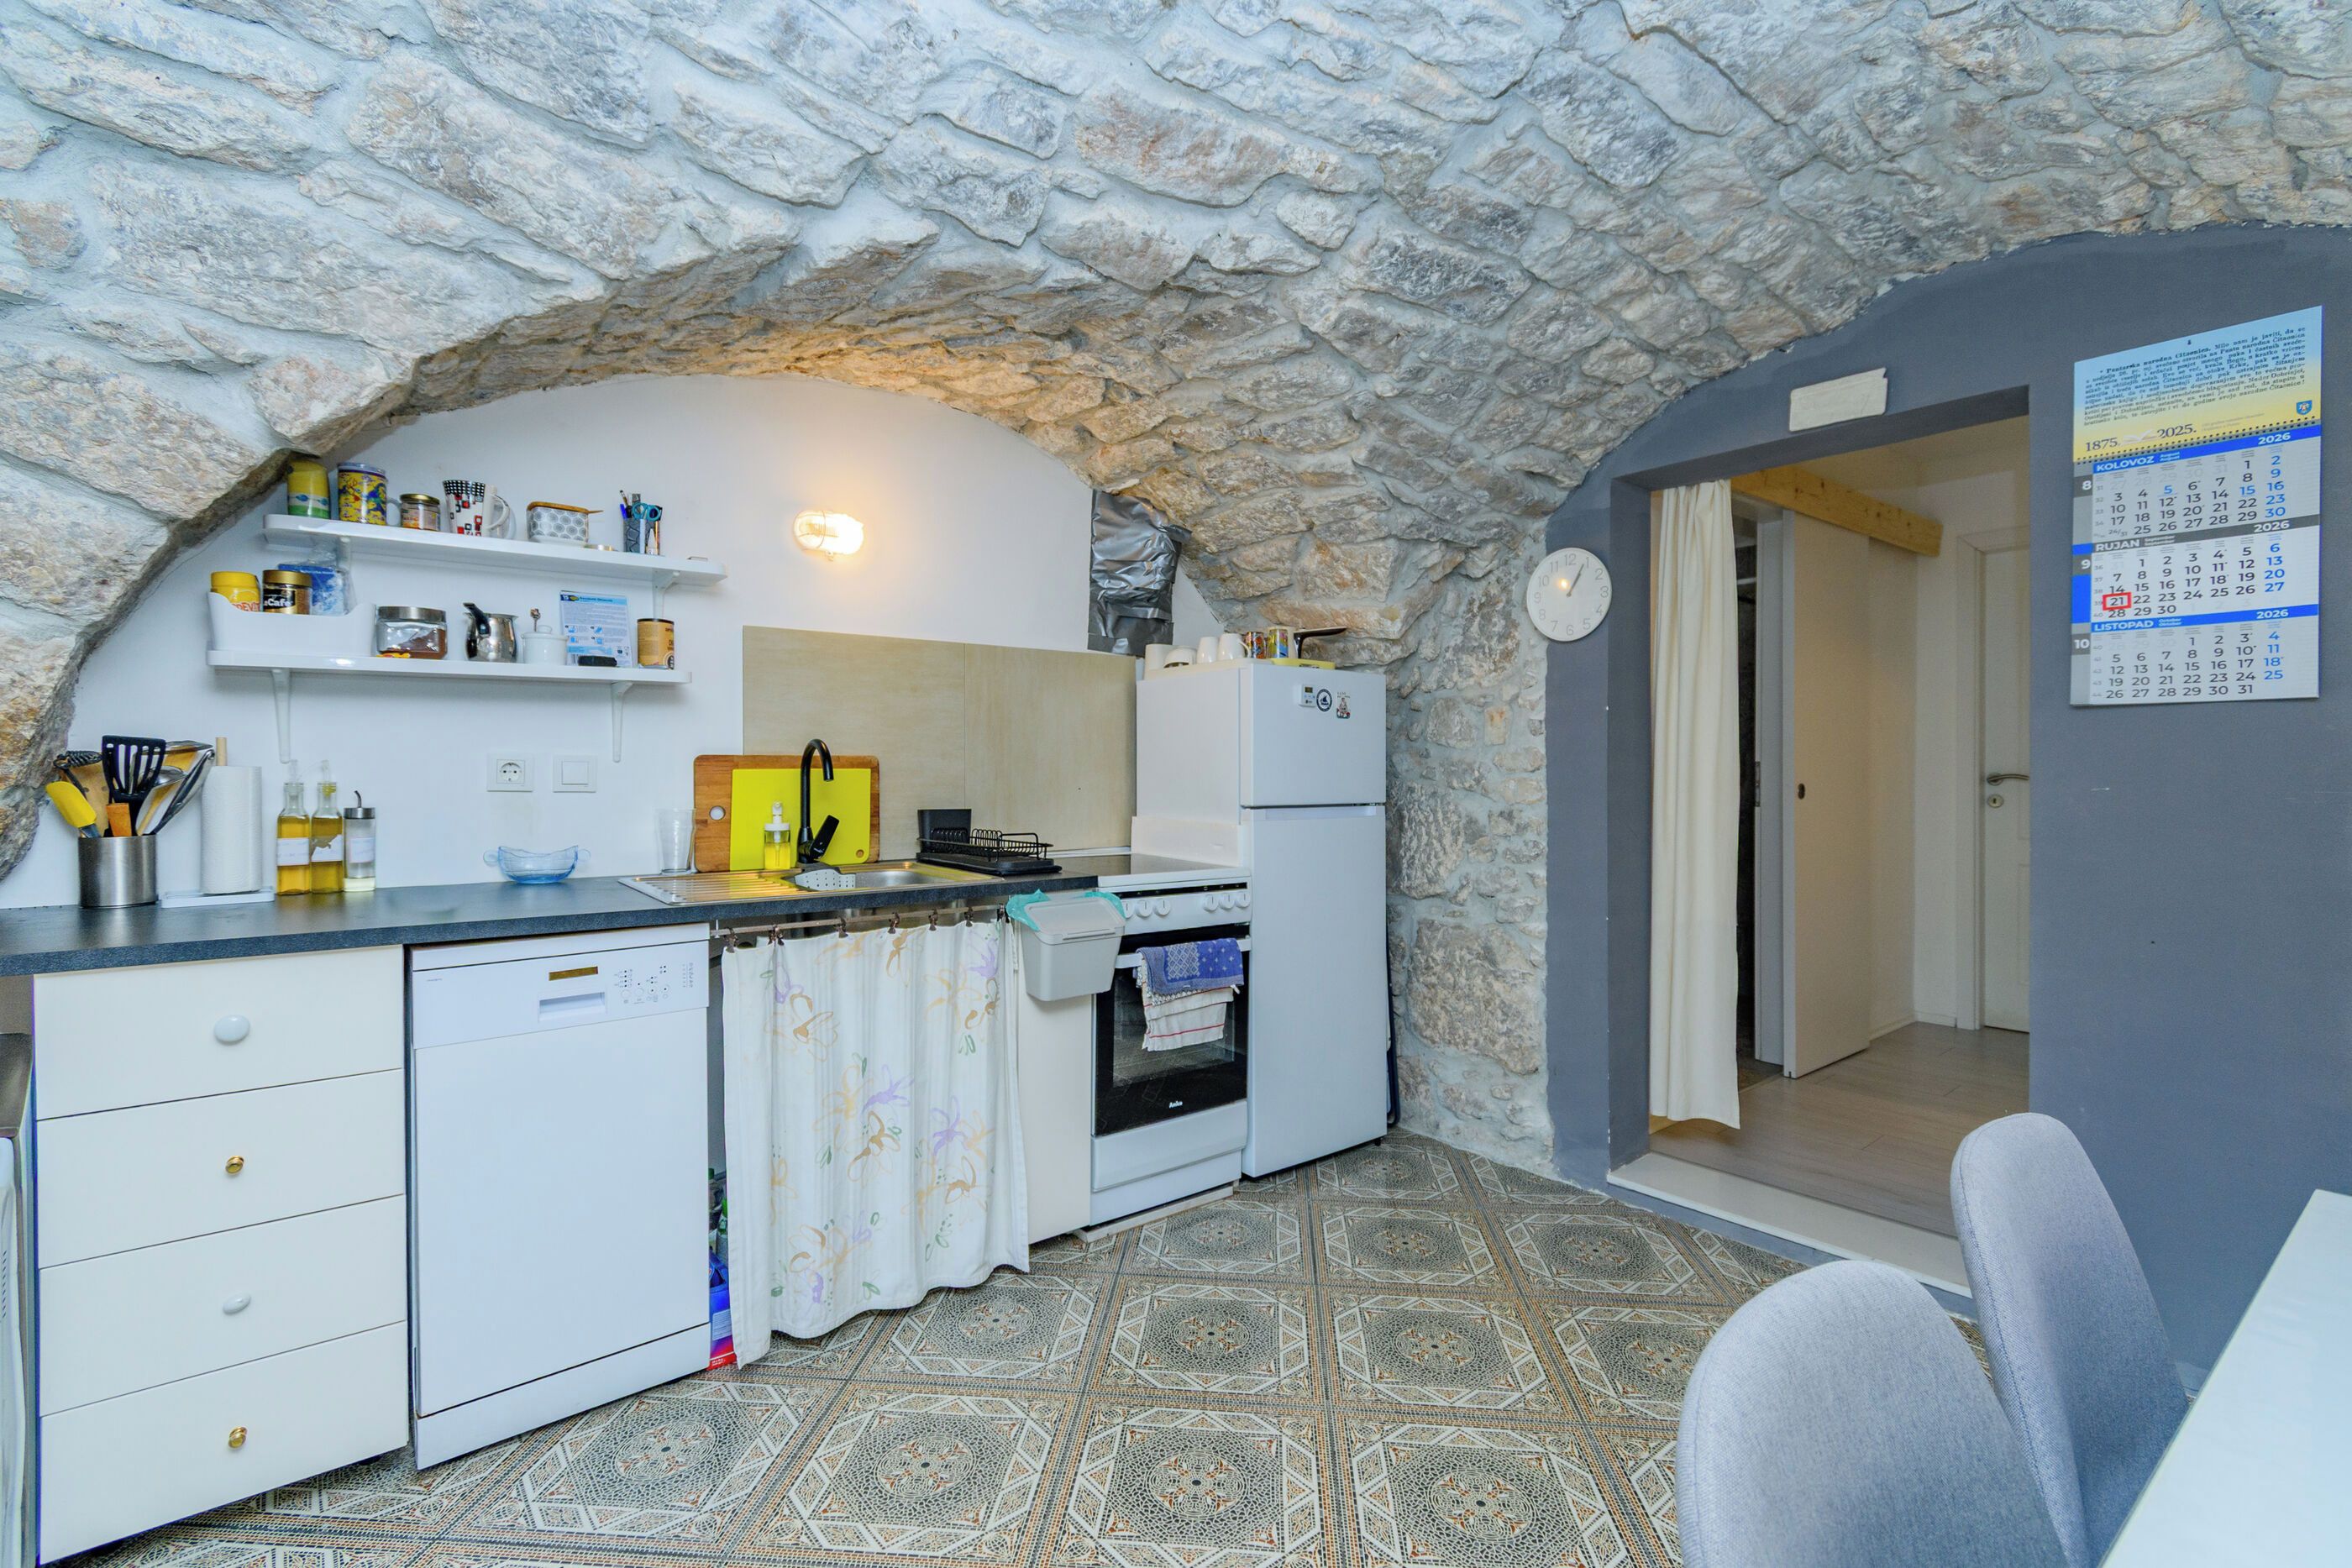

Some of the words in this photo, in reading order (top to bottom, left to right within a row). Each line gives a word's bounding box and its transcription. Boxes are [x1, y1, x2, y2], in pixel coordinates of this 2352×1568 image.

[2157, 424, 2197, 438] 2025.
[2258, 432, 2291, 445] 2026
[2096, 456, 2155, 471] KOLOVOZ
[2244, 460, 2250, 469] 1
[2271, 455, 2281, 465] 2
[2082, 480, 2091, 490] 8
[2114, 493, 2122, 501] 3
[2164, 485, 2173, 494] 5
[2188, 481, 2197, 490] 6
[2216, 477, 2225, 486] 7
[2243, 473, 2253, 482] 8
[2271, 469, 2281, 478] 9
[2111, 504, 2126, 514] 10
[2137, 501, 2147, 510] 11
[2160, 497, 2174, 507] 12
[2187, 493, 2201, 503] 13
[2212, 490, 2229, 500] 14
[2240, 485, 2255, 496] 15
[2267, 481, 2284, 491] 16
[2111, 516, 2125, 525] 17
[2135, 512, 2150, 522] 18
[2160, 510, 2175, 519] 19
[2183, 506, 2202, 517] 20
[2213, 502, 2227, 512] 21
[2239, 498, 2257, 509] 22
[2266, 494, 2285, 505] 23
[2134, 525, 2151, 535] 25
[2159, 522, 2176, 532] 26
[2185, 518, 2202, 528] 27
[2209, 515, 2229, 525] 28
[2238, 511, 2257, 522] 29
[2265, 506, 2286, 517] 30
[2254, 520, 2290, 532] 2026
[2096, 539, 2139, 552] RUJAN
[1565, 553, 1577, 566] 12
[2164, 556, 2171, 564] 2
[2189, 553, 2197, 562] 3
[2213, 550, 2223, 559] 4
[2243, 547, 2251, 556] 5
[2270, 543, 2280, 553] 6
[1550, 561, 1558, 573] 11
[1586, 557, 1589, 569] 1
[2082, 559, 2091, 569] 9
[2113, 574, 2122, 582] 7
[2138, 571, 2146, 579] 8
[2162, 569, 2171, 577] 9
[2185, 565, 2201, 574] 10
[2213, 563, 2223, 572] 11
[2239, 559, 2255, 569] 12
[2266, 556, 2282, 565] 13
[1595, 568, 1603, 580] 2
[1538, 575, 1550, 587] 10
[2110, 585, 2125, 595] 14
[2134, 583, 2149, 591] 15
[2160, 580, 2175, 590] 16
[2186, 578, 2201, 587] 17
[2210, 575, 2226, 585] 18
[2239, 572, 2255, 582] 19
[2265, 569, 2285, 579] 20
[1534, 592, 1541, 603] 9
[1600, 586, 1609, 598] 3
[2110, 597, 2124, 606] 21
[2134, 595, 2150, 604] 22
[2159, 593, 2176, 602] 23
[2184, 590, 2202, 600] 24
[2211, 588, 2229, 597] 25
[2236, 585, 2255, 595] 26
[2265, 582, 2285, 592] 27
[1539, 609, 1546, 621] 8
[1595, 605, 1604, 616] 4
[2108, 608, 2126, 618] 28
[2134, 607, 2152, 616] 29
[2158, 605, 2176, 614] 30
[2256, 609, 2289, 619] 2026
[1551, 621, 1558, 632] 7
[1566, 625, 1574, 636] 6
[1583, 618, 1591, 630] 5
[2094, 620, 2154, 631] LISTOPAD
[2074, 639, 2090, 648] 10
[2190, 637, 2194, 646] 1
[2215, 636, 2223, 644] 2
[2240, 633, 2249, 642] 3
[2269, 632, 2280, 640] 4
[2113, 654, 2121, 663] 5
[2137, 653, 2145, 661] 6
[2162, 651, 2171, 659] 7
[2187, 649, 2197, 658] 8
[2214, 648, 2223, 657] 9
[2236, 646, 2253, 655] 10
[2267, 644, 2279, 653] 11
[2111, 666, 2124, 674] 12
[2134, 664, 2148, 674] 13
[2158, 663, 2175, 672] 14
[2185, 662, 2200, 671] 15
[2211, 660, 2227, 669] 16
[2238, 658, 2254, 668] 17
[2264, 658, 2281, 666] 18
[2108, 678, 2124, 686] 19
[2132, 677, 2150, 685] 20
[2159, 675, 2172, 684] 21
[2183, 674, 2201, 684] 22
[2209, 673, 2228, 683] 23
[2236, 672, 2256, 681] 24
[2265, 670, 2283, 679] 25
[2106, 690, 2124, 699] 26
[2132, 689, 2150, 698] 27
[2158, 688, 2176, 697] 28
[2182, 687, 2201, 696] 29
[2208, 685, 2229, 695] 30
[2238, 684, 2252, 694] 31
